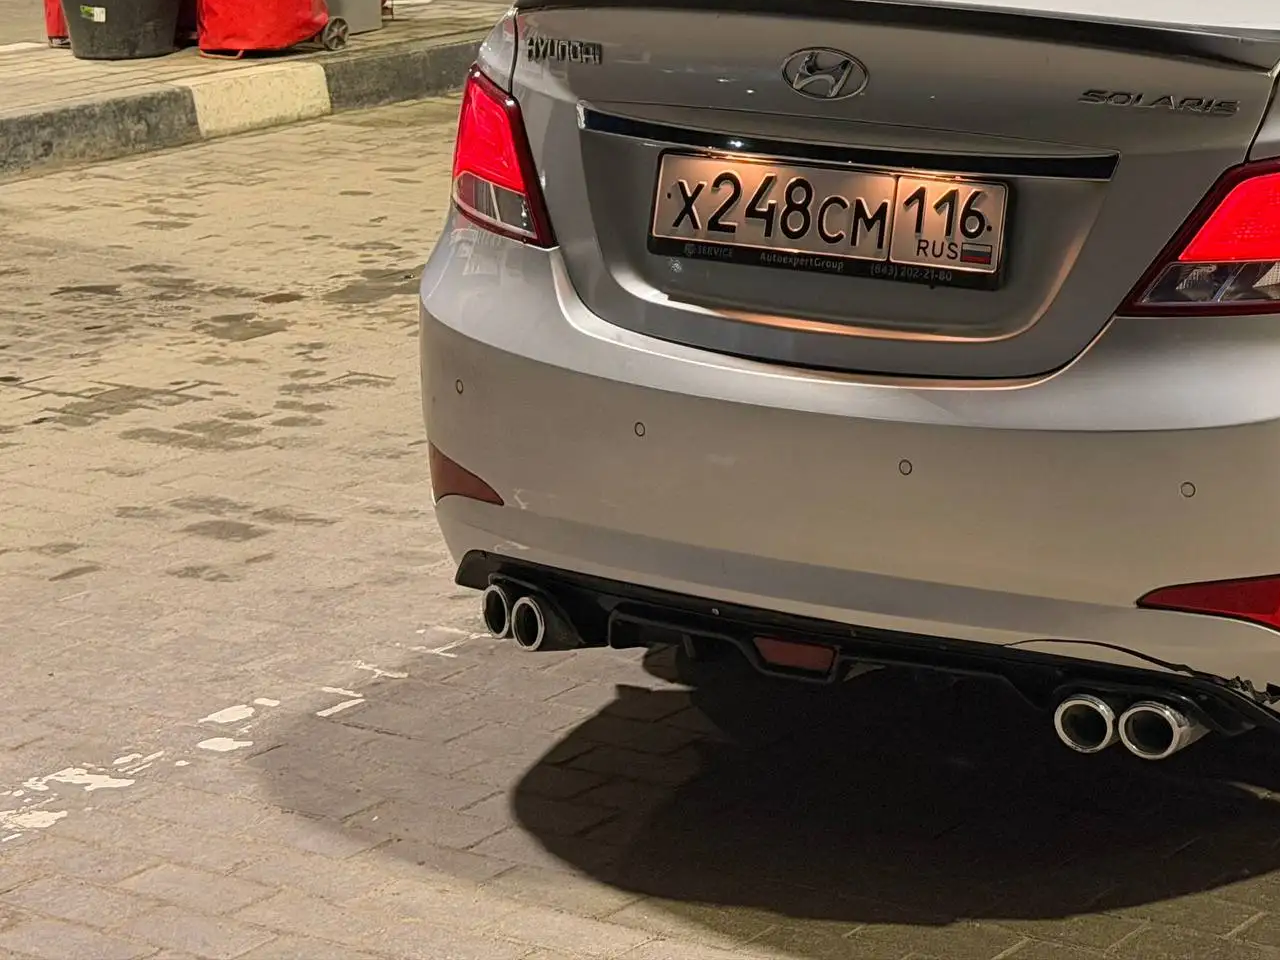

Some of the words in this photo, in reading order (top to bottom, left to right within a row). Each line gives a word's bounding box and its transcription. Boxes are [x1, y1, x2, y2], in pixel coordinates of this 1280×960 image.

[527, 37, 602, 64] HYUNDAI
[1078, 89, 1241, 117] SOLARIS
[902, 185, 989, 240] 116
[916, 239, 959, 260] RUS
